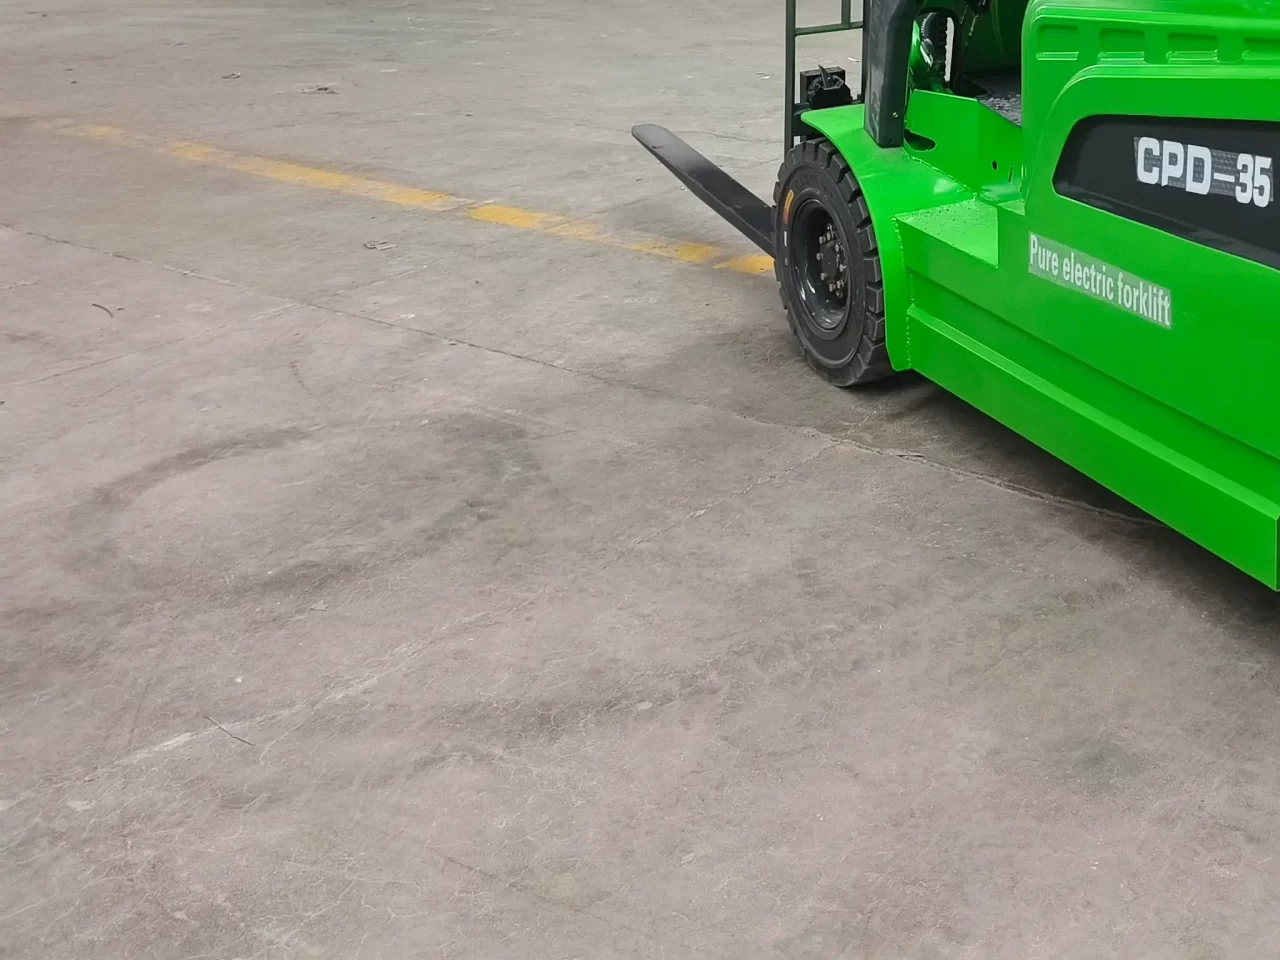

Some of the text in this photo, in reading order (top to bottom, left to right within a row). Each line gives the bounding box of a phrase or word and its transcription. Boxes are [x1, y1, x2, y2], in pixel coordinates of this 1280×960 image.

[1137, 137, 1272, 208] CPD-35
[1030, 234, 1171, 326] Pure electric forklift
